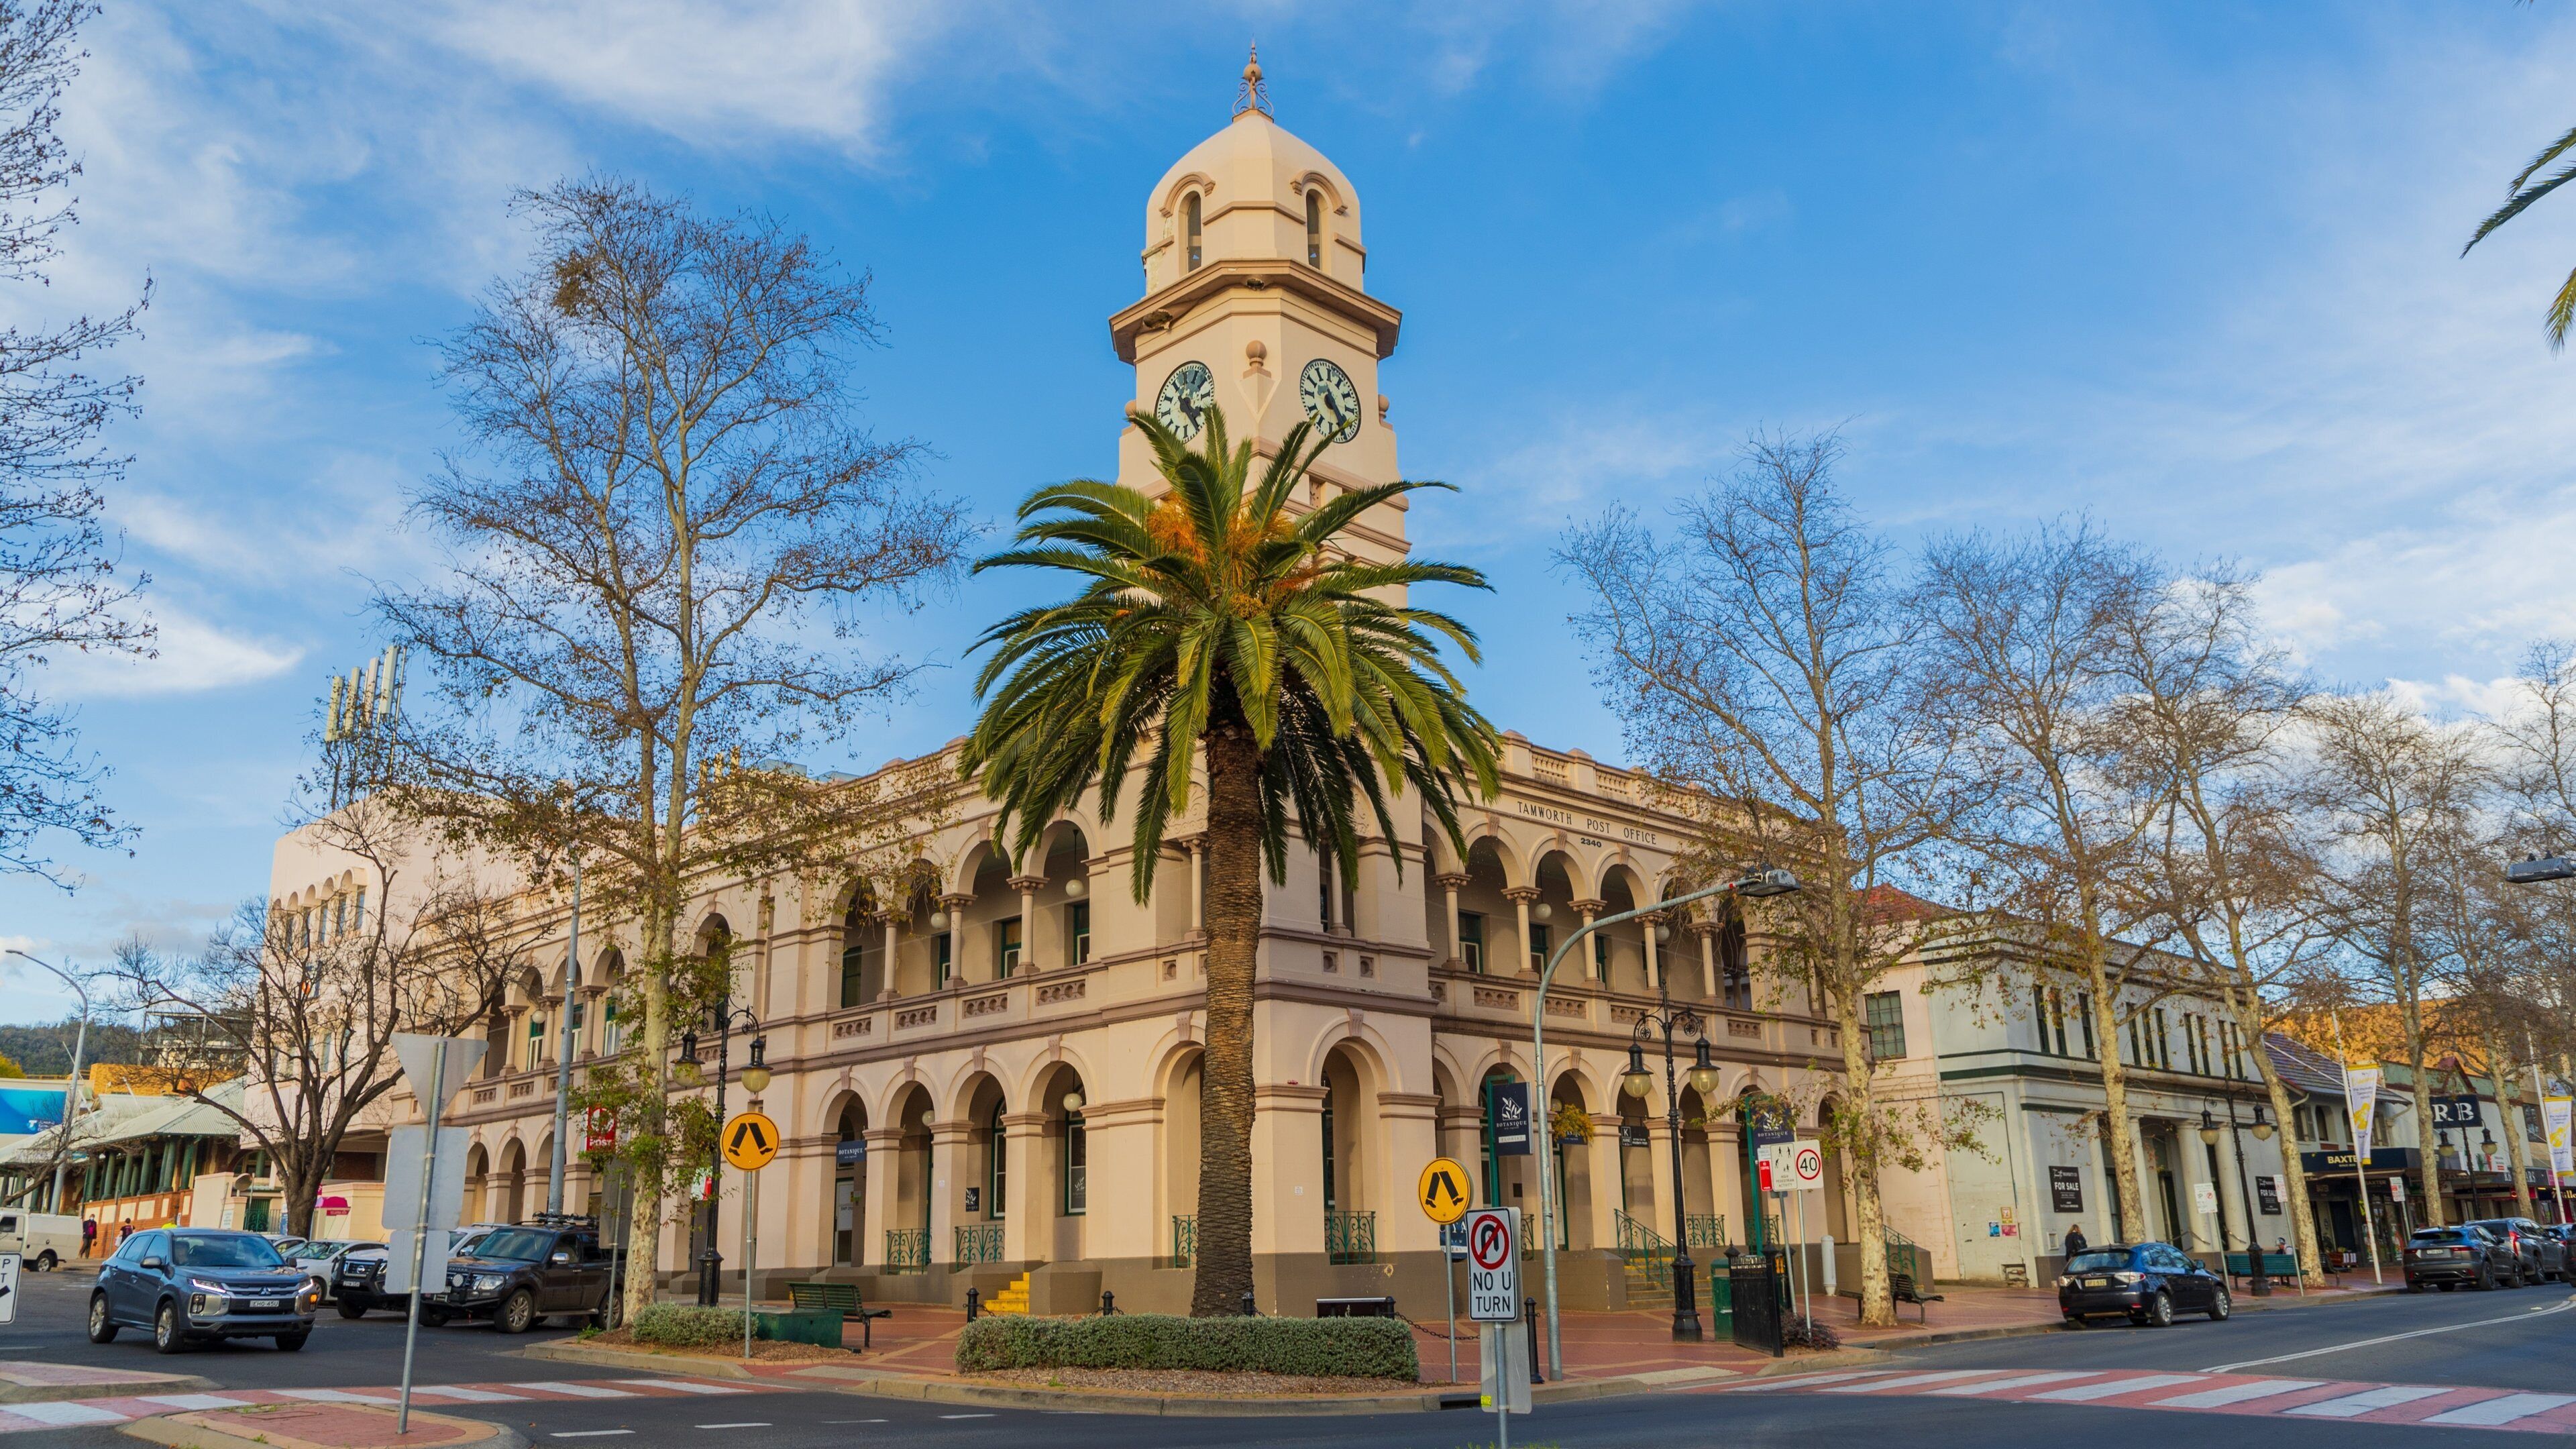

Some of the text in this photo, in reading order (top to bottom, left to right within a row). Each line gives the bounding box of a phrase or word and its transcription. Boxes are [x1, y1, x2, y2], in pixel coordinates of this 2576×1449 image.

[1517, 801, 1656, 845] TAMWORTH POST OFFICE
[1580, 837, 1602, 847] 2340
[1800, 1157, 1817, 1172] 40
[2327, 1155, 2358, 1164] BAXTE
[2054, 1182, 2080, 1191] FOR SALE
[1473, 1271, 1511, 1291] NO U
[1476, 1295, 1511, 1312] TURN
